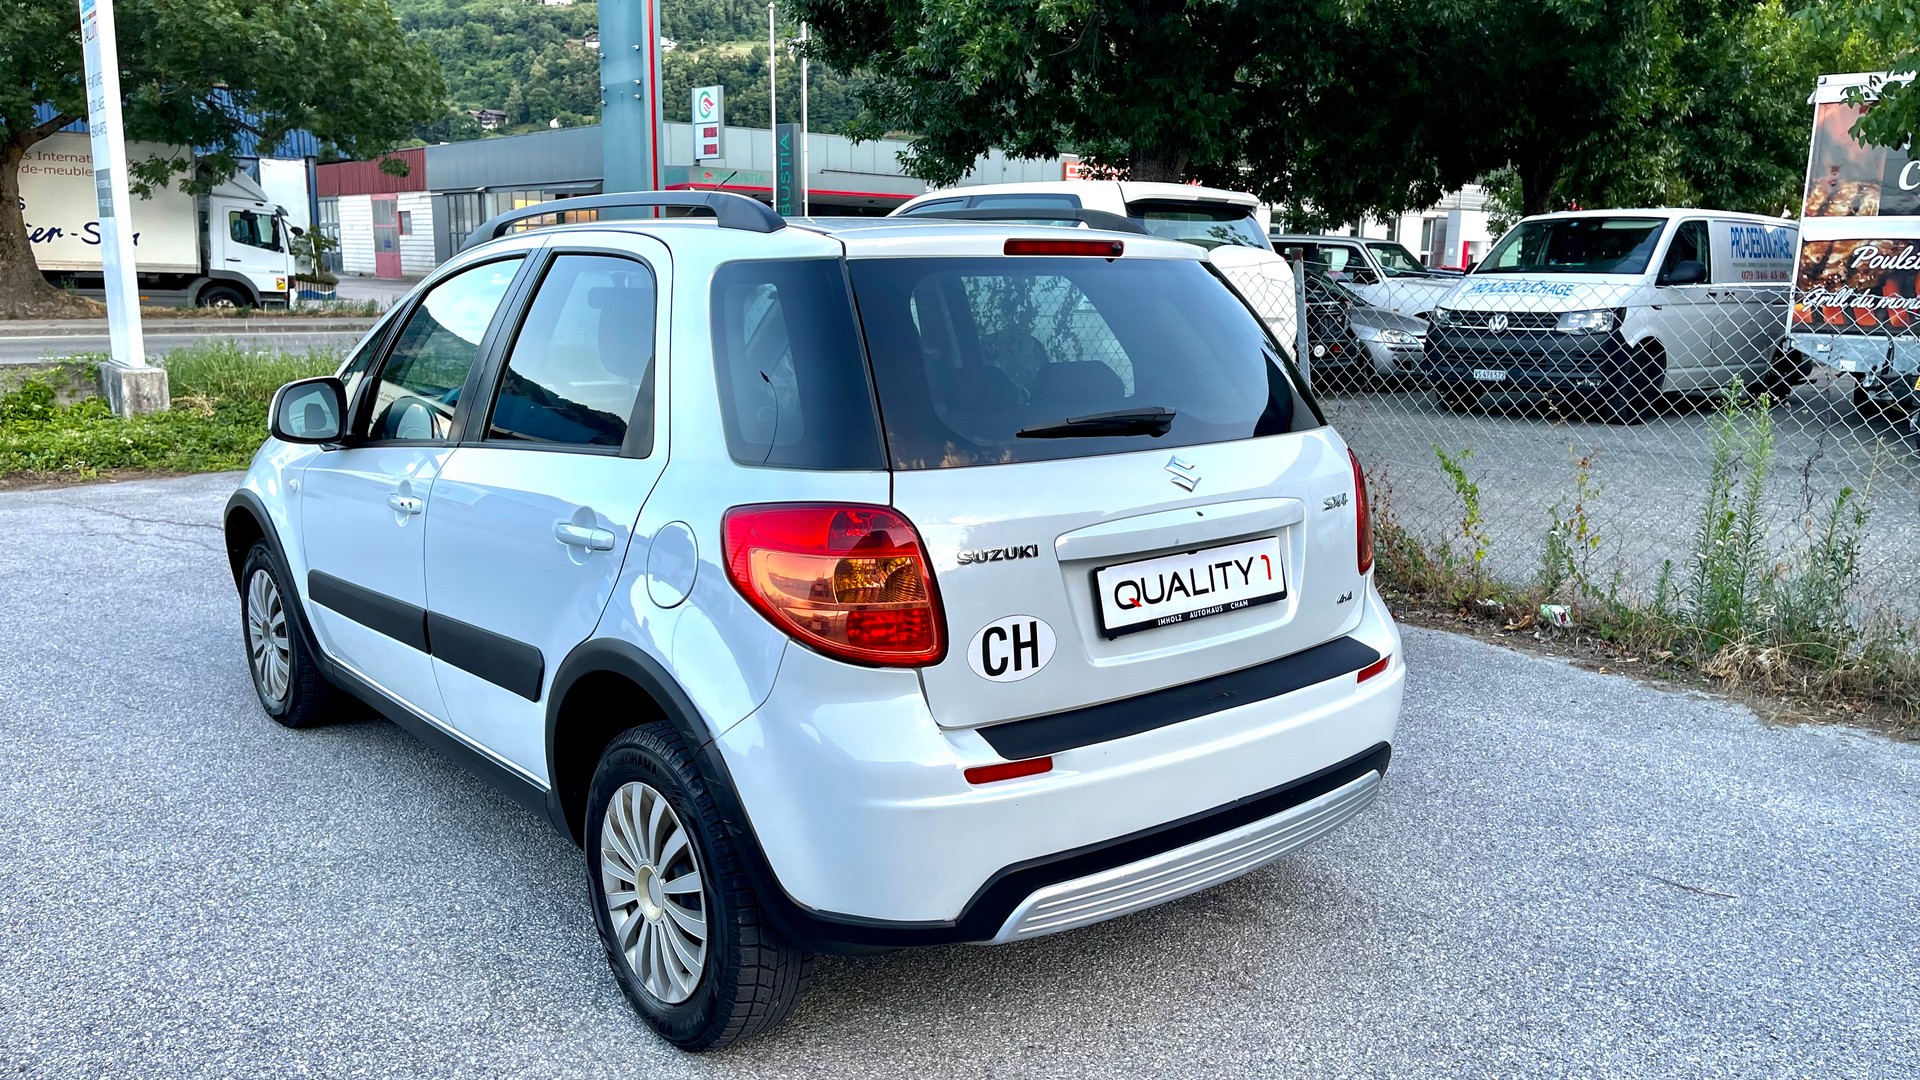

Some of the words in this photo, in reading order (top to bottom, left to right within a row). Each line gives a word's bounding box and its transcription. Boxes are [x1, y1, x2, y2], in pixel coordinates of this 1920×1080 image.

[780, 132, 791, 216] BUSTIA
[1322, 493, 1349, 511] SX4
[956, 544, 1039, 565] SUZUKI
[1114, 556, 1255, 610] QUALITY
[1157, 615, 1183, 626] IMHOLZ
[1189, 605, 1224, 619] AUTOHAUS
[1230, 600, 1249, 610] CHAM
[982, 620, 1039, 676] CH
